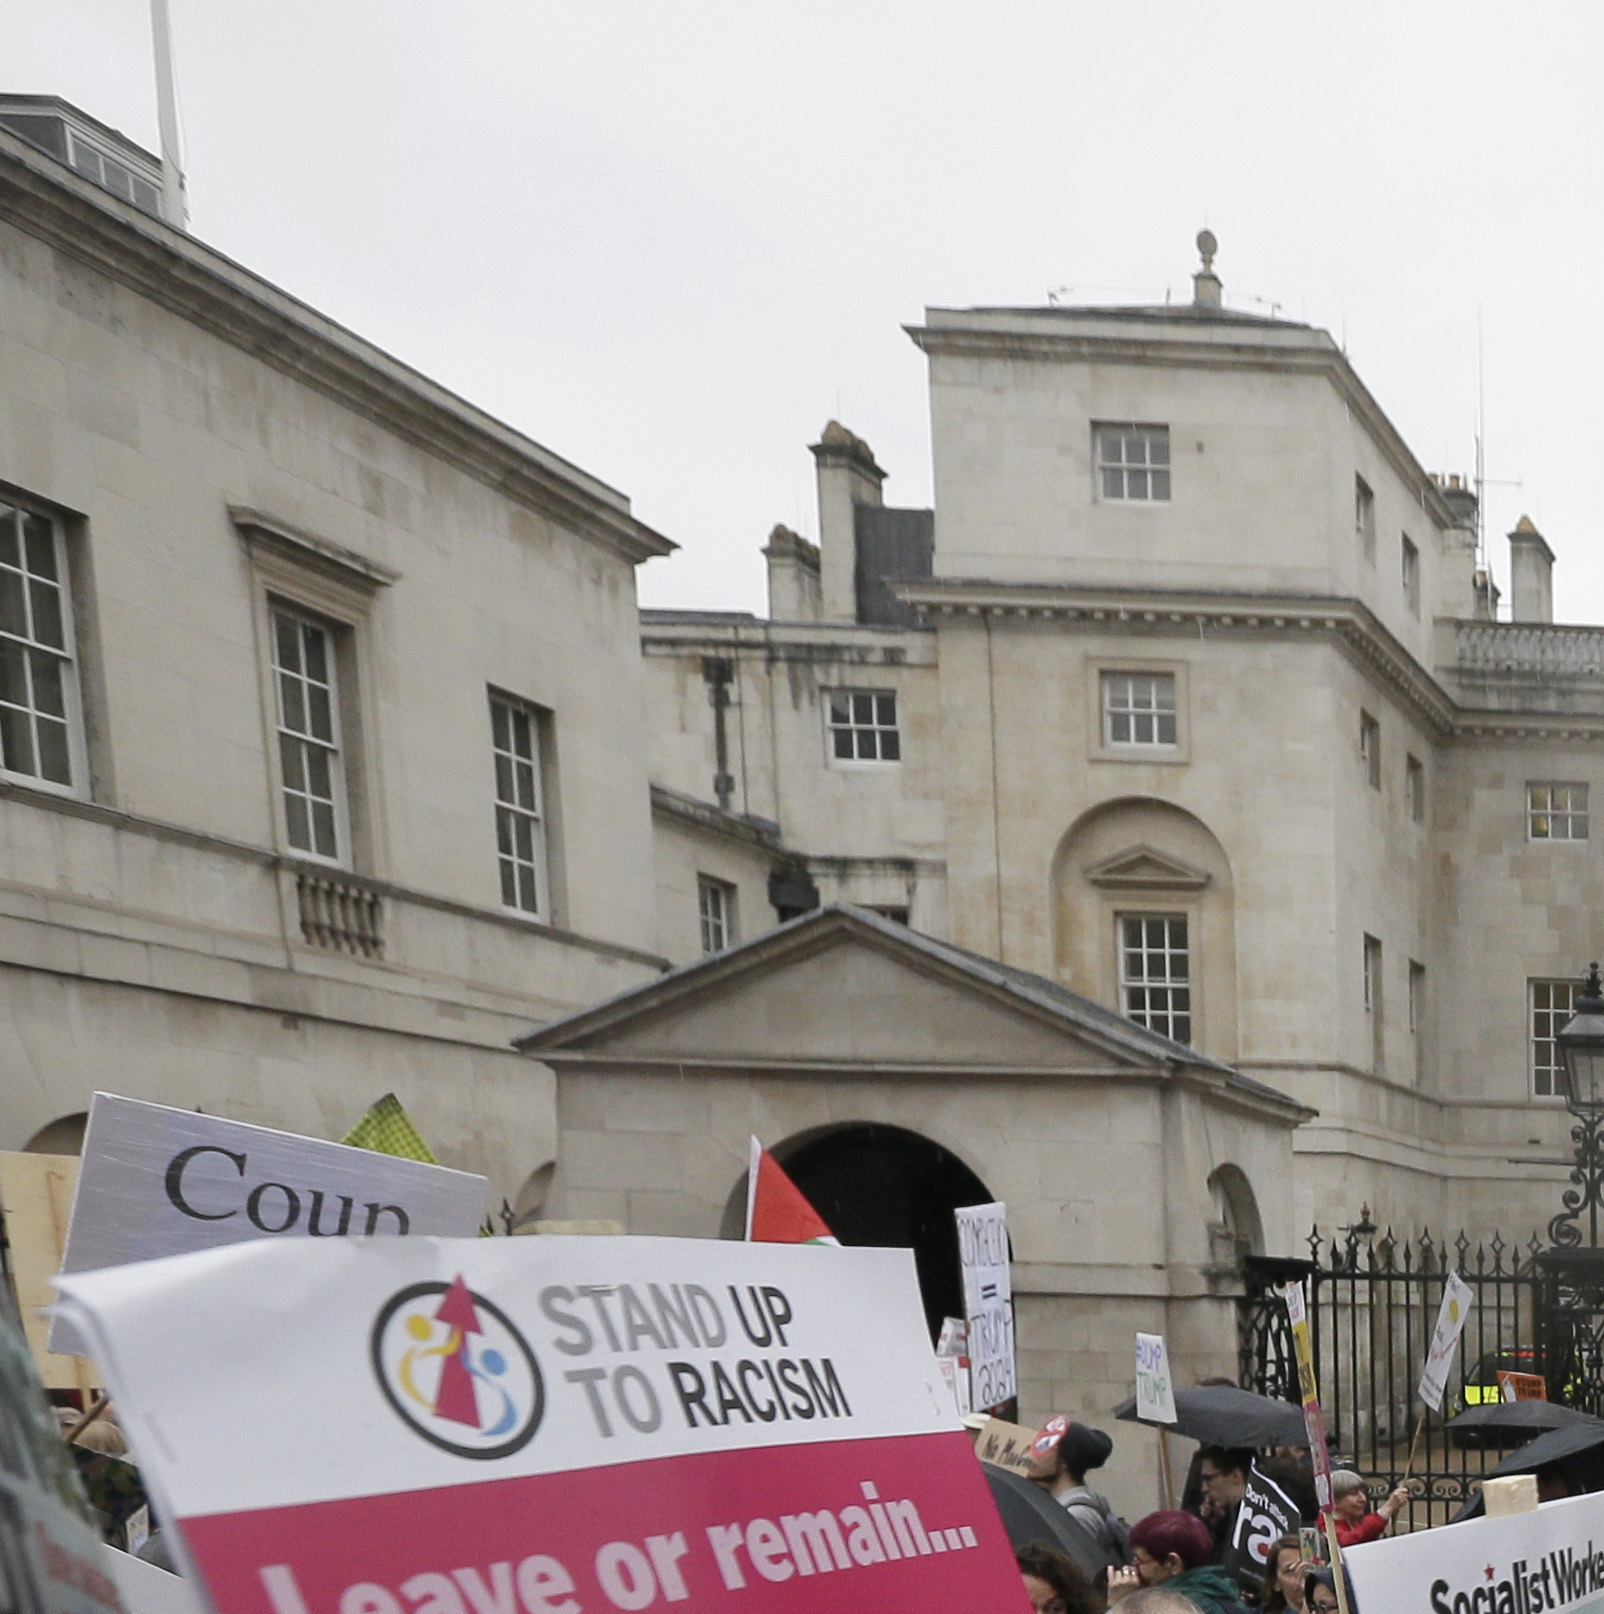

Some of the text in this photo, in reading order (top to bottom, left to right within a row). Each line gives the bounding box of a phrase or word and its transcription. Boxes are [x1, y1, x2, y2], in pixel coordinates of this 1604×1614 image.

[537, 1286, 792, 1357] STAND UP
[566, 1357, 853, 1437] TO RACISM
[1244, 1482, 1269, 1511] Don't
[595, 1529, 690, 1612] or
[714, 1480, 980, 1591] remain...
